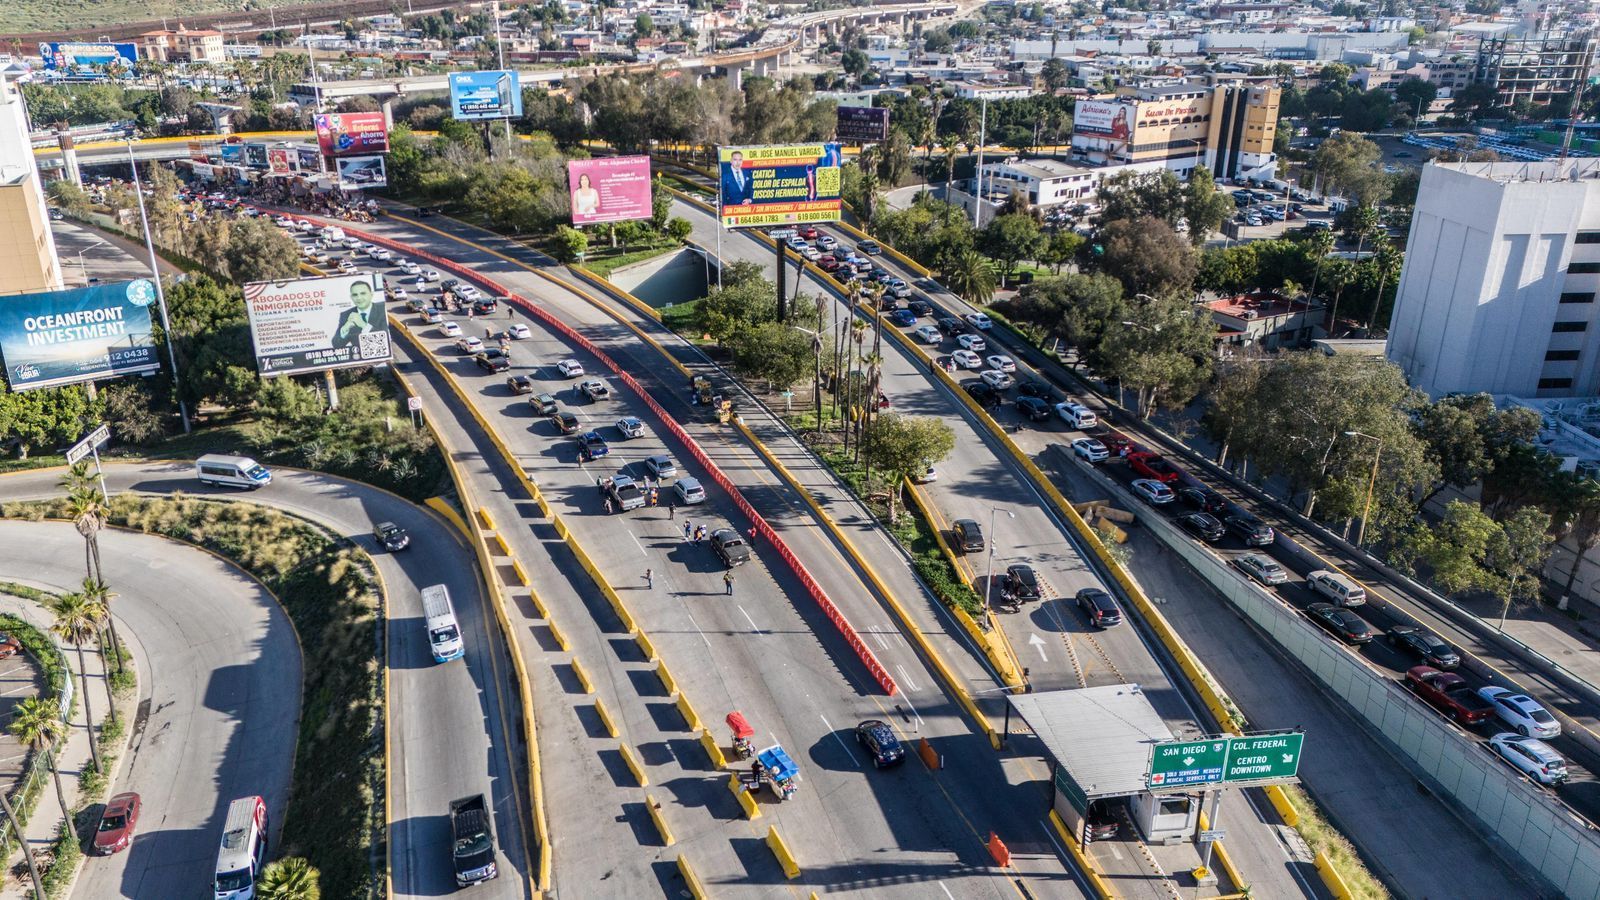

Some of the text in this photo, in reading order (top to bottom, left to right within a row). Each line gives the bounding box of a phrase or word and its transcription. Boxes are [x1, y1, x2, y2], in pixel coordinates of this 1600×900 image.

[775, 148, 798, 157] MANUEL
[799, 148, 822, 156] VARGAS
[753, 179, 772, 189] DOLOR
[781, 178, 806, 187] ESPALDA
[753, 189, 775, 199] DISCOS
[740, 216, 752, 224] 664
[253, 291, 311, 304] ABOGADOS
[24, 306, 123, 332] OCEANFRONT
[256, 320, 301, 328] DEPORTACIONES
[26, 321, 126, 347] INVESTMENT
[104, 352, 122, 362] 912
[124, 348, 148, 360] 0438
[1233, 739, 1288, 750] COL. FEDERAL
[1163, 745, 1206, 756] SAN DIEGO
[1236, 756, 1268, 766] CENTRO
[1230, 764, 1272, 775] DOWNTOWN
